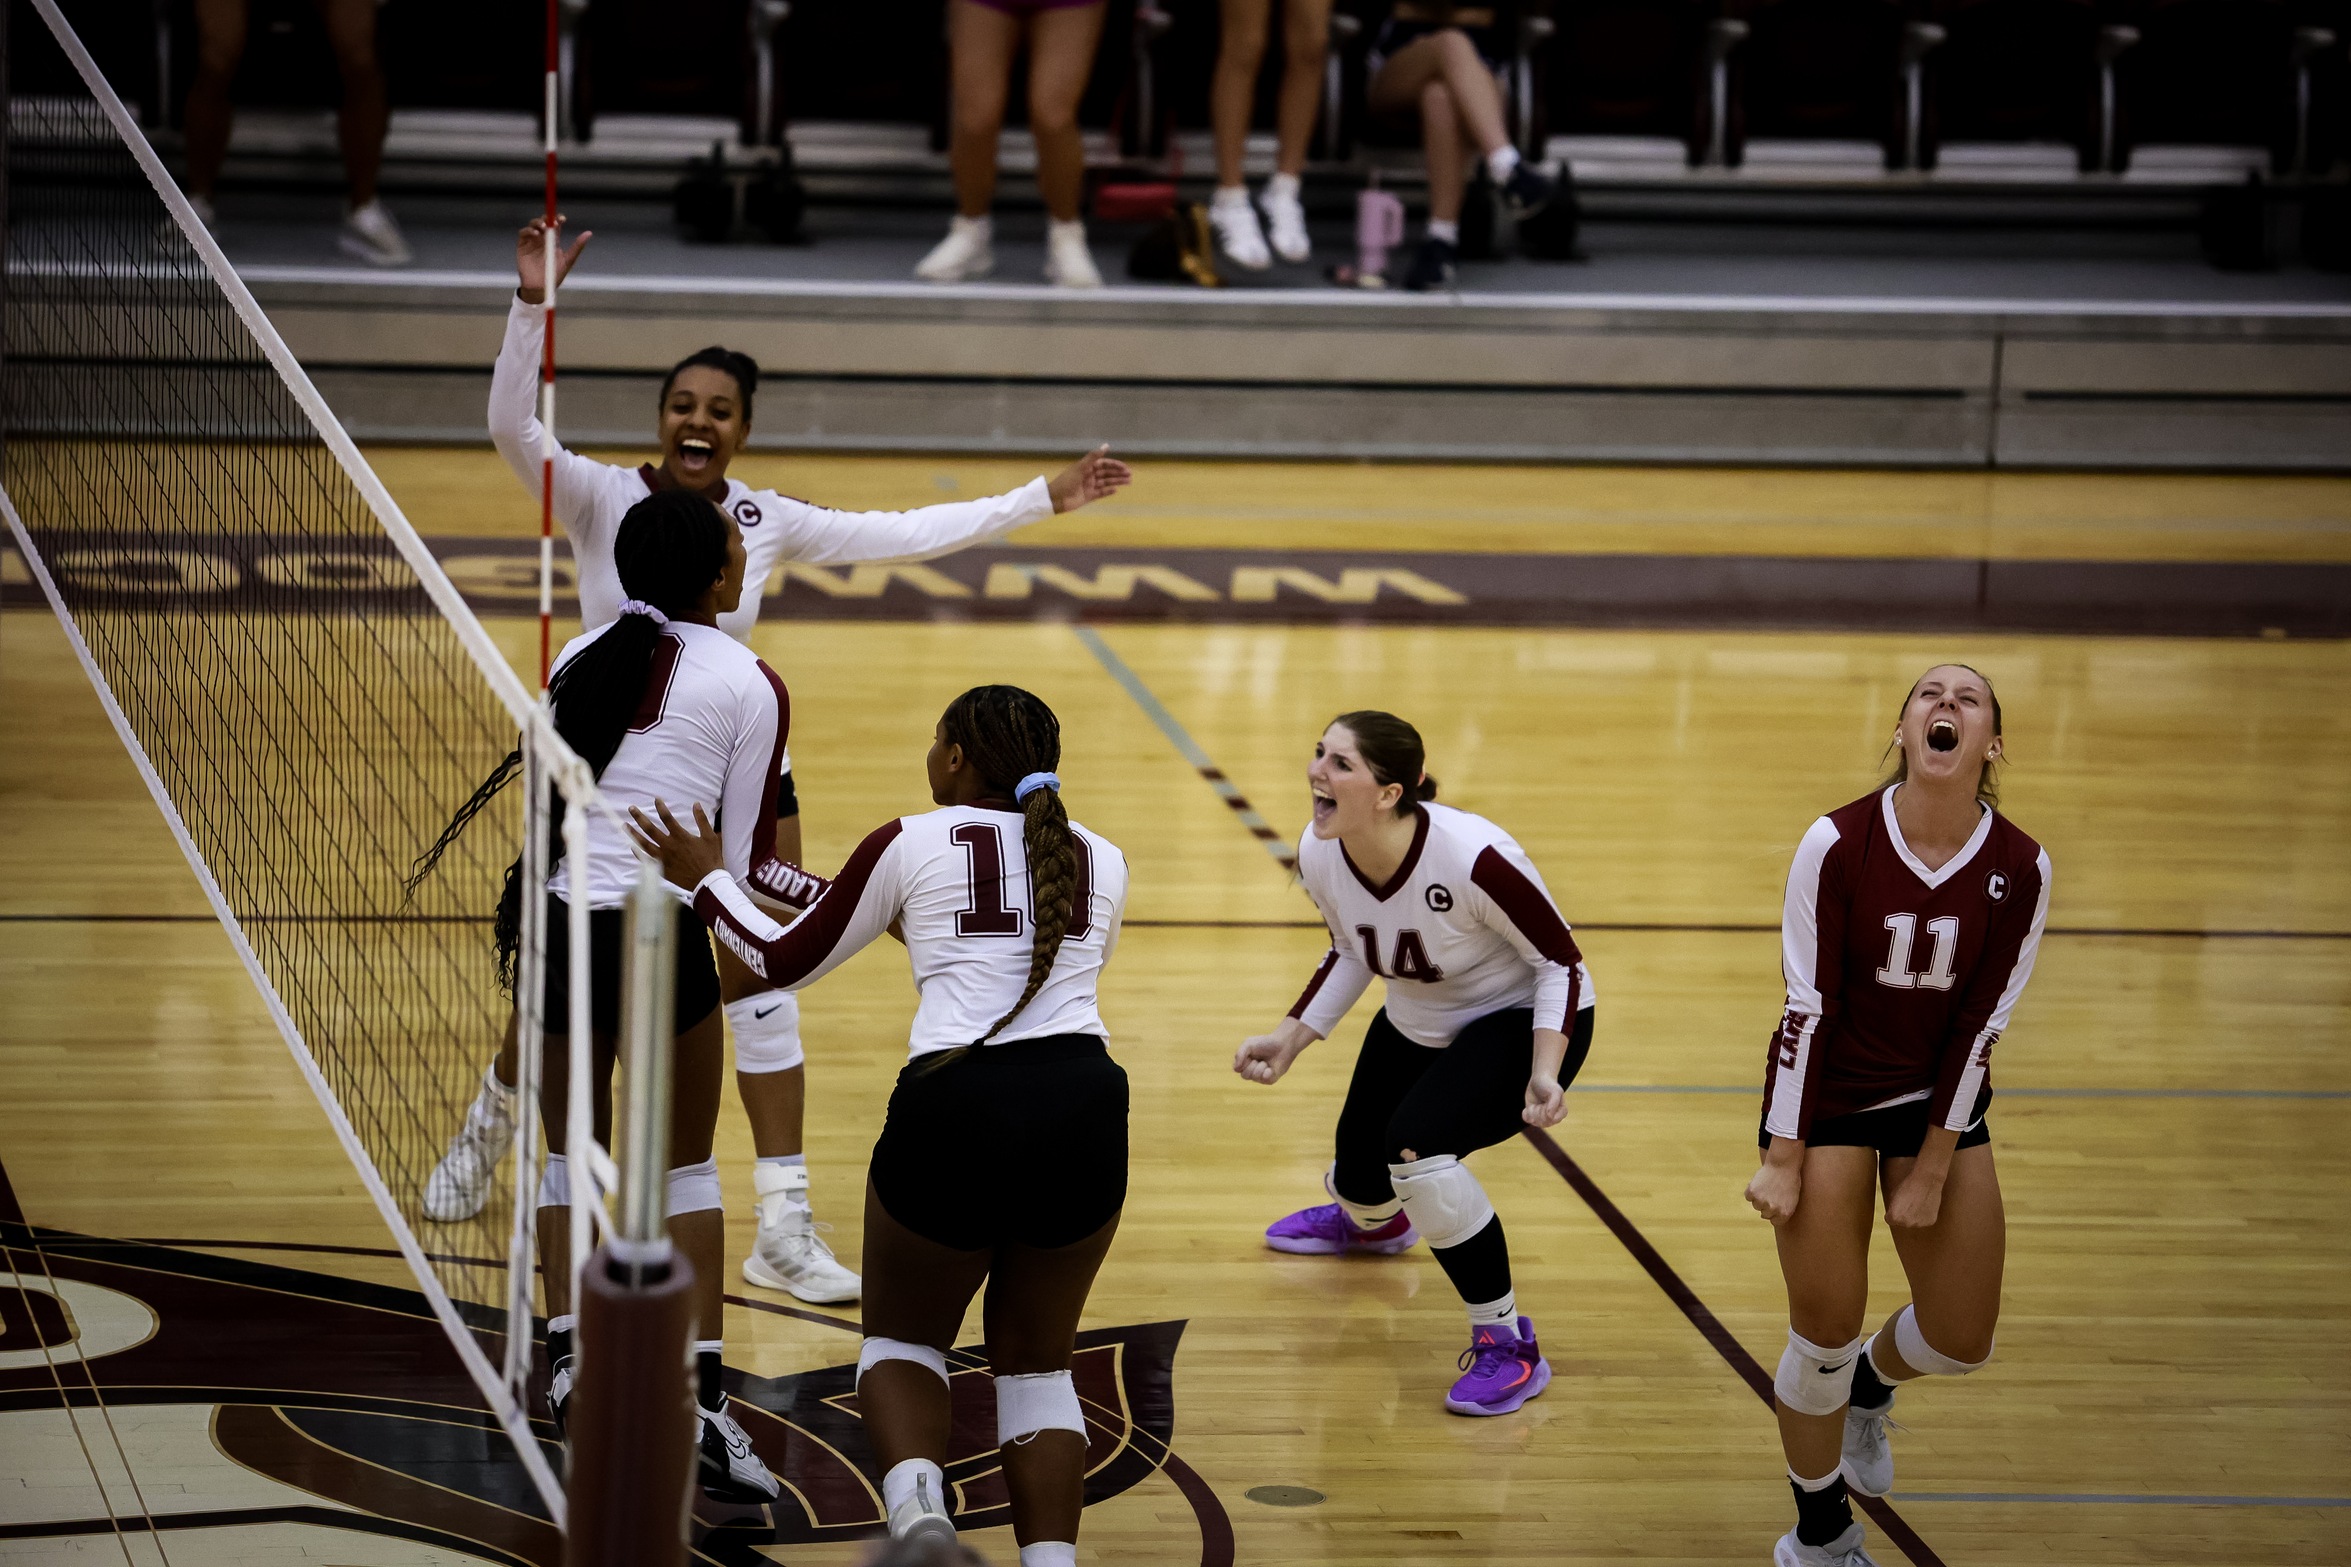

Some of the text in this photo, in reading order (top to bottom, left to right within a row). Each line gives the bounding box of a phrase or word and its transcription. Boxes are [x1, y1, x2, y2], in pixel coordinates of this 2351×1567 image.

[736, 502, 760, 525] C
[1427, 886, 1451, 910] C
[1986, 872, 2006, 901] C
[1356, 924, 1445, 983] 14
[1876, 912, 1959, 991] 11
